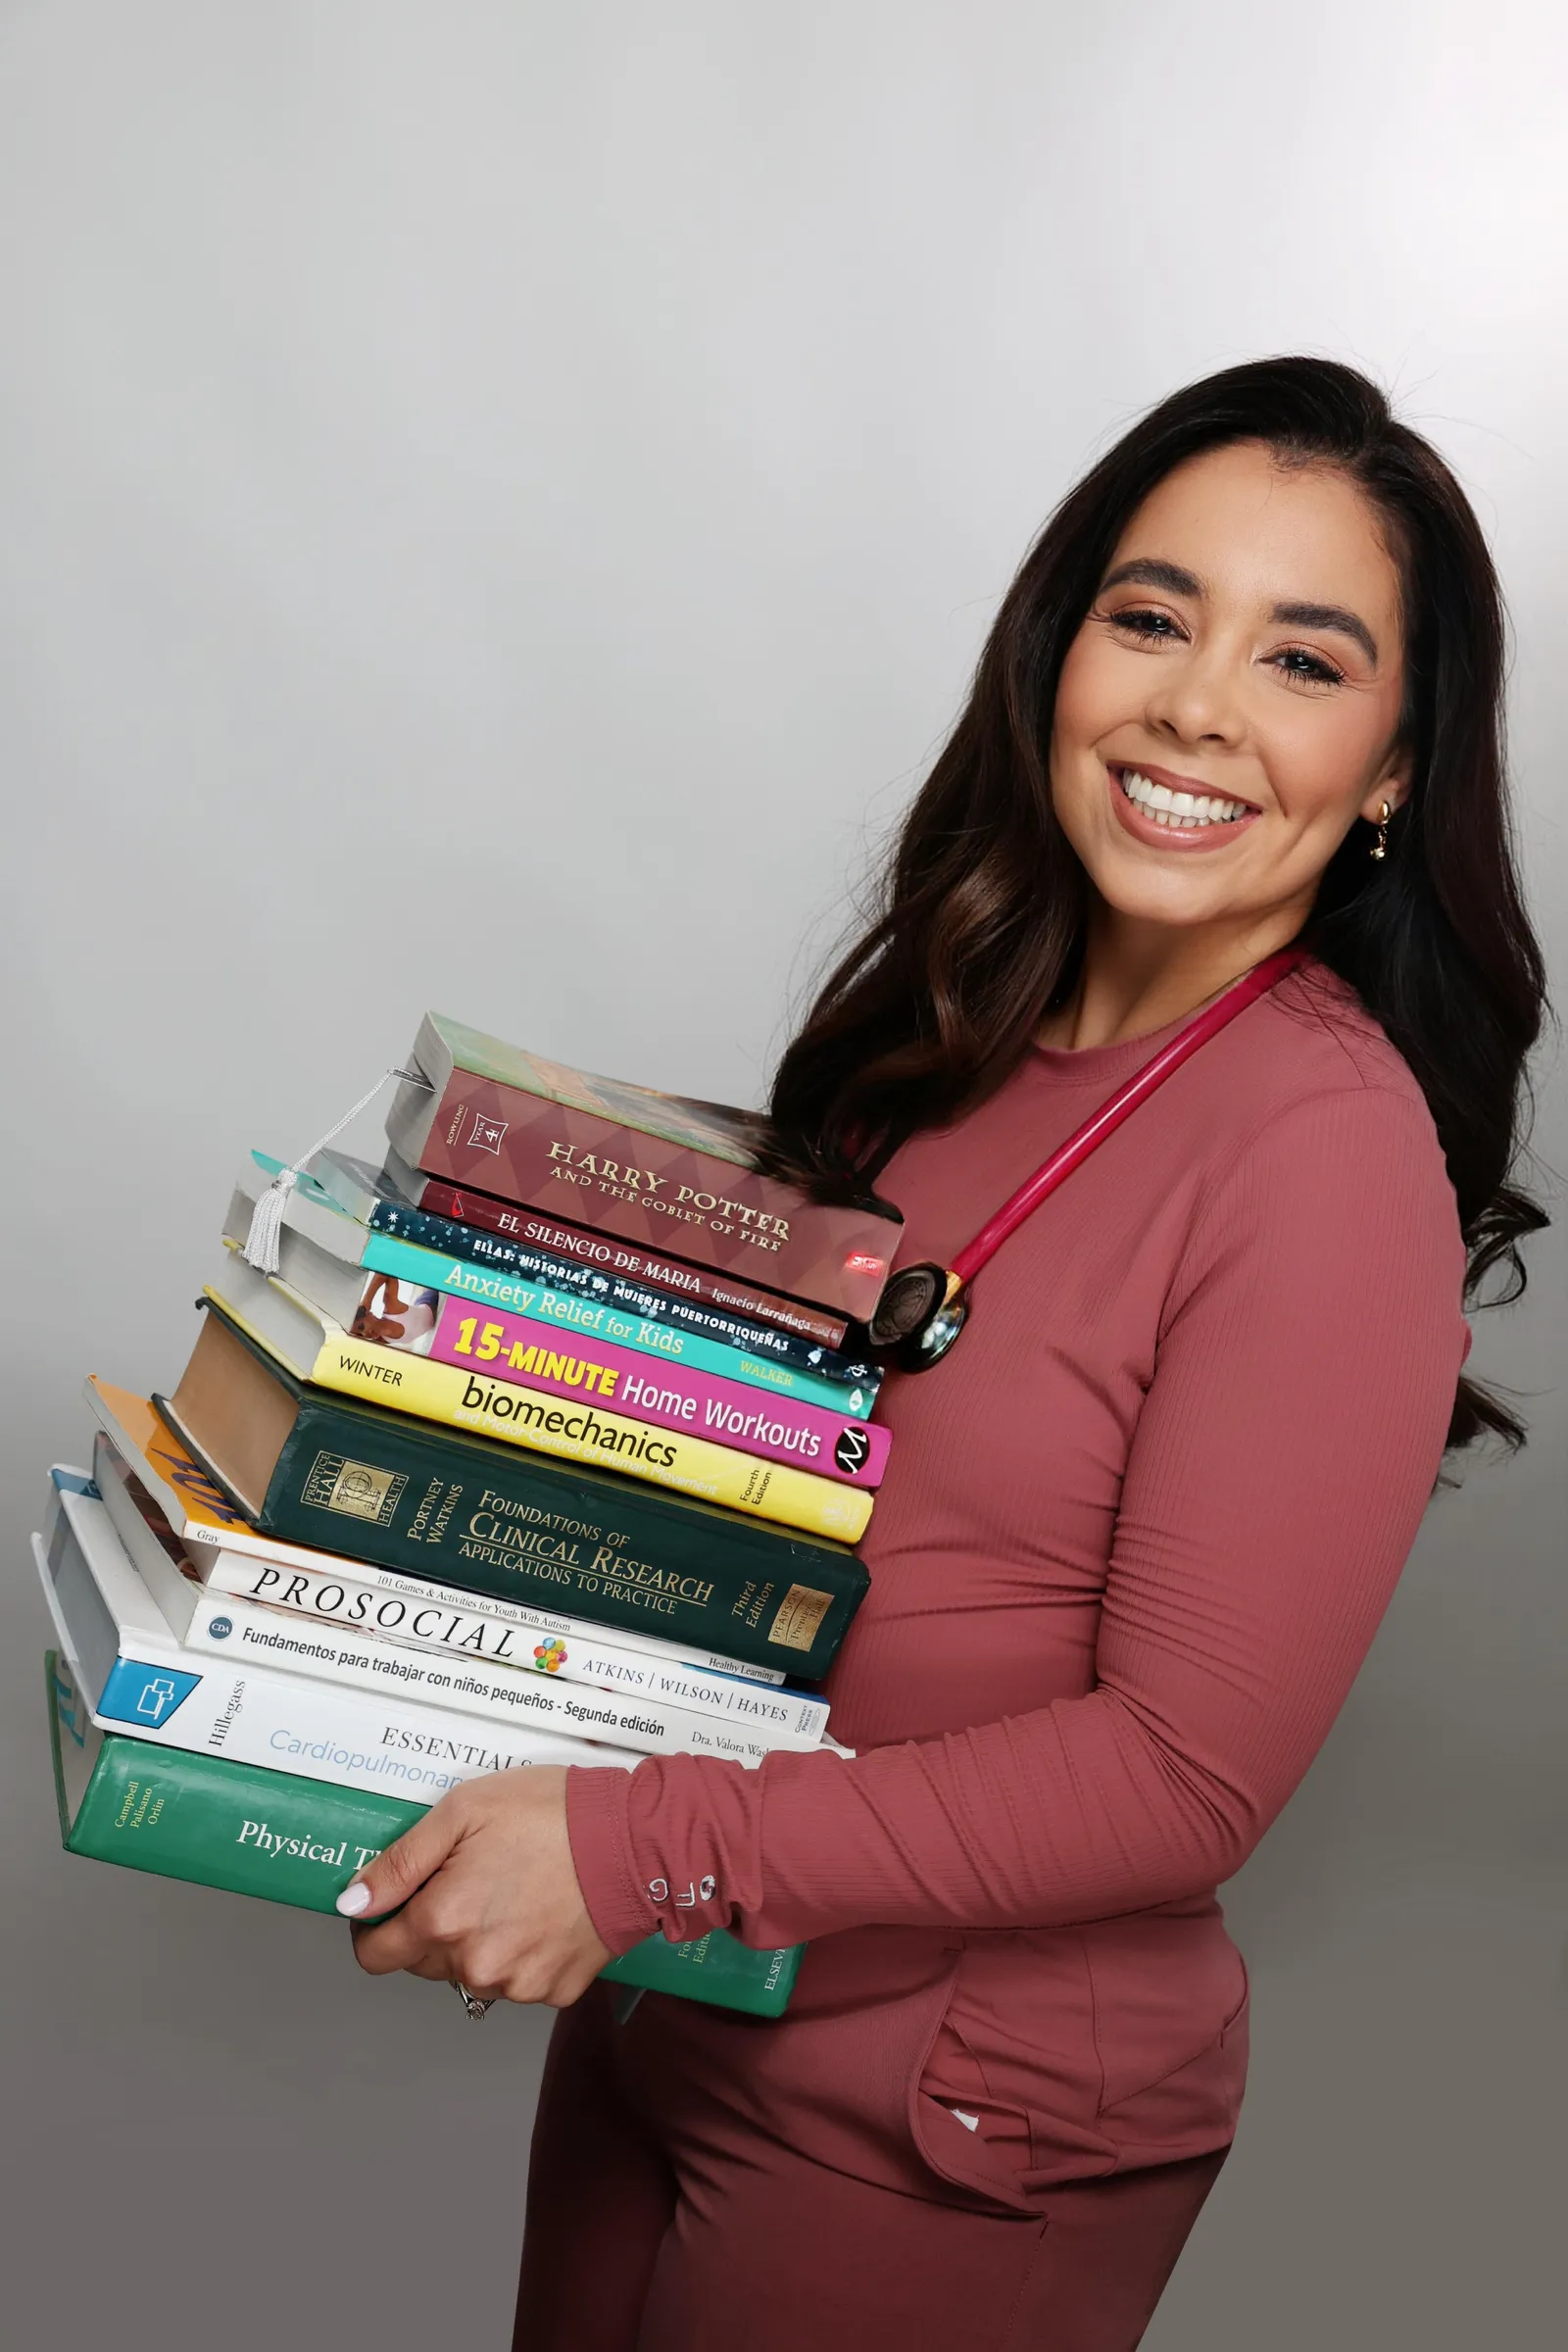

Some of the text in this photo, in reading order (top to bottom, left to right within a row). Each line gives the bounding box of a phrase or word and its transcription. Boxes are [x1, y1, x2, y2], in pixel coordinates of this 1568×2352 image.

[446, 1103, 465, 1145] ROWLING
[473, 1121, 485, 1142] YEAR
[485, 1129, 499, 1142] 4
[545, 1141, 790, 1241] HARRY POTTER
[550, 1166, 782, 1252] AND THE GOBLET OF FIRE
[498, 1212, 519, 1233] EL
[524, 1223, 611, 1262] SILENCIO
[612, 1252, 640, 1272] DE
[642, 1261, 702, 1294] MARIA
[712, 1288, 754, 1310] Ignacio
[756, 1304, 811, 1331] Larrañaga
[444, 1264, 684, 1354] Anxiety Relief for Kids
[473, 1240, 515, 1261] ELLAS:
[518, 1254, 588, 1285] HISTORIAS
[592, 1277, 610, 1293] DE
[613, 1286, 666, 1311] MUJERES
[671, 1305, 789, 1351] PUERTORRIQUEÑAS
[339, 1355, 403, 1387] WINTER
[454, 1317, 821, 1456] 15-MINUTE Home Workouts
[740, 1360, 794, 1386] WALKER
[461, 1376, 677, 1467] biomechanics
[455, 1409, 481, 1425] and
[529, 1428, 581, 1454] Control
[583, 1445, 598, 1458] of
[601, 1449, 648, 1476] Human
[651, 1465, 718, 1495] Movement
[306, 1453, 330, 1502] PRENTICE
[314, 1459, 344, 1506] HALL
[379, 1475, 406, 1523] HEALTH
[739, 1469, 760, 1501] Fourth
[752, 1471, 772, 1505] Edition
[407, 1477, 444, 1541] PORTNEY
[426, 1485, 464, 1544] WATKINS
[478, 1490, 631, 1548] FOUNDATIONS OF
[197, 1529, 220, 1544] Gray
[468, 1511, 714, 1602] CLINICAL RESEARCH
[458, 1542, 678, 1615] APPLICATIONS TO PRACTICE
[731, 1581, 757, 1617] Third
[249, 1567, 515, 1658] PROSOCIAL
[376, 1575, 571, 1632] 101 Games & Activities for Youth With Autism
[746, 1582, 775, 1629] Edition
[773, 1590, 802, 1638] PEARSON
[790, 1603, 812, 1640] Prentice
[809, 1599, 826, 1619] Hall
[211, 1623, 229, 1634] CDA
[242, 1627, 336, 1661] Fundamentos
[337, 1652, 368, 1668] para
[371, 1657, 425, 1682] trabajar
[427, 1672, 451, 1688] con
[453, 1676, 489, 1695] niños
[490, 1686, 554, 1711] pequeños
[564, 1701, 616, 1726] Segunda
[619, 1715, 664, 1737] edición
[582, 1660, 645, 1684] ATKINS
[660, 1678, 723, 1704] WILSON
[737, 1698, 789, 1721] HAYES
[709, 1657, 774, 1682] Healthy Learning
[208, 1680, 246, 1746] Hillegass
[795, 1705, 808, 1734] CONTEXT
[802, 1709, 813, 1732] PRESS
[270, 1730, 463, 1789] Cardiopulmonar
[691, 1731, 712, 1746] Dra.
[716, 1737, 745, 1753] Valora
[115, 1781, 139, 1828] Campbell
[130, 1788, 153, 1828] Palisano
[148, 1798, 165, 1825] Orlin
[236, 1820, 347, 1866] Physical
